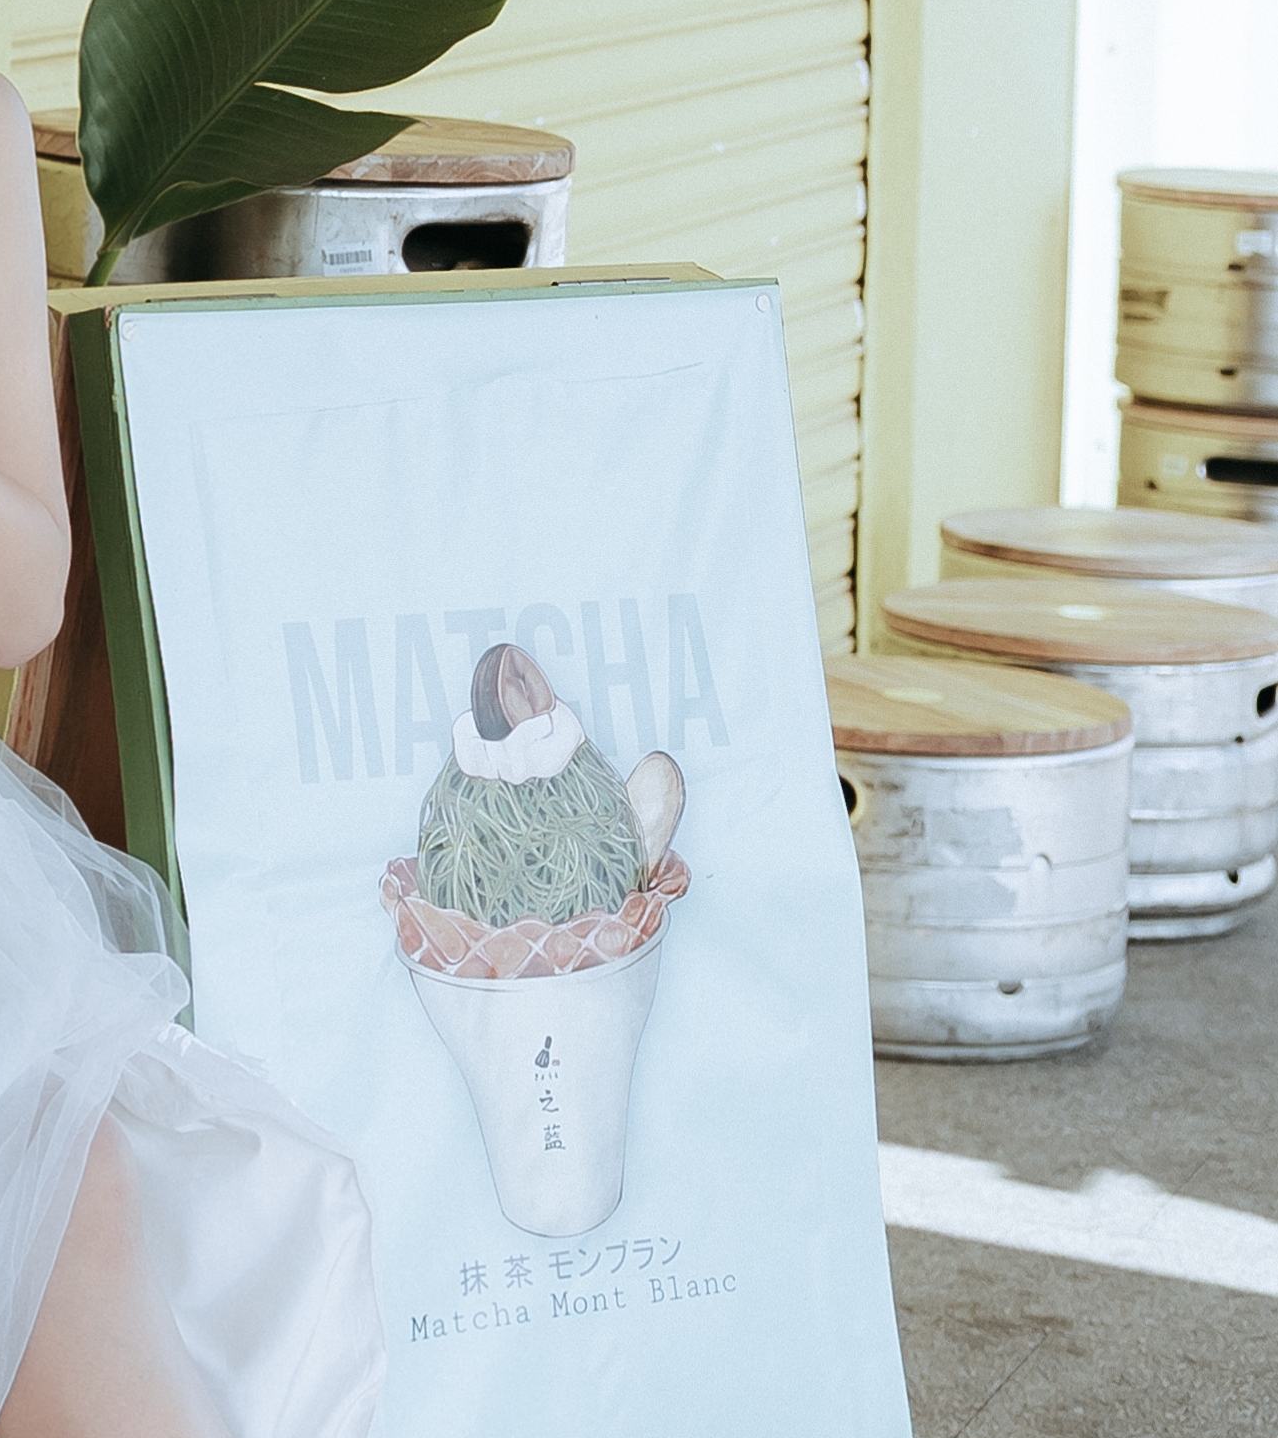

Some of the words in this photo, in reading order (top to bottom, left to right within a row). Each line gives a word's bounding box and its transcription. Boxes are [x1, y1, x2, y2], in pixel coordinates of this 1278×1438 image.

[409, 1301, 532, 1343] Matcha
[550, 1286, 628, 1319] Mont
[648, 1273, 738, 1304] Blanc
